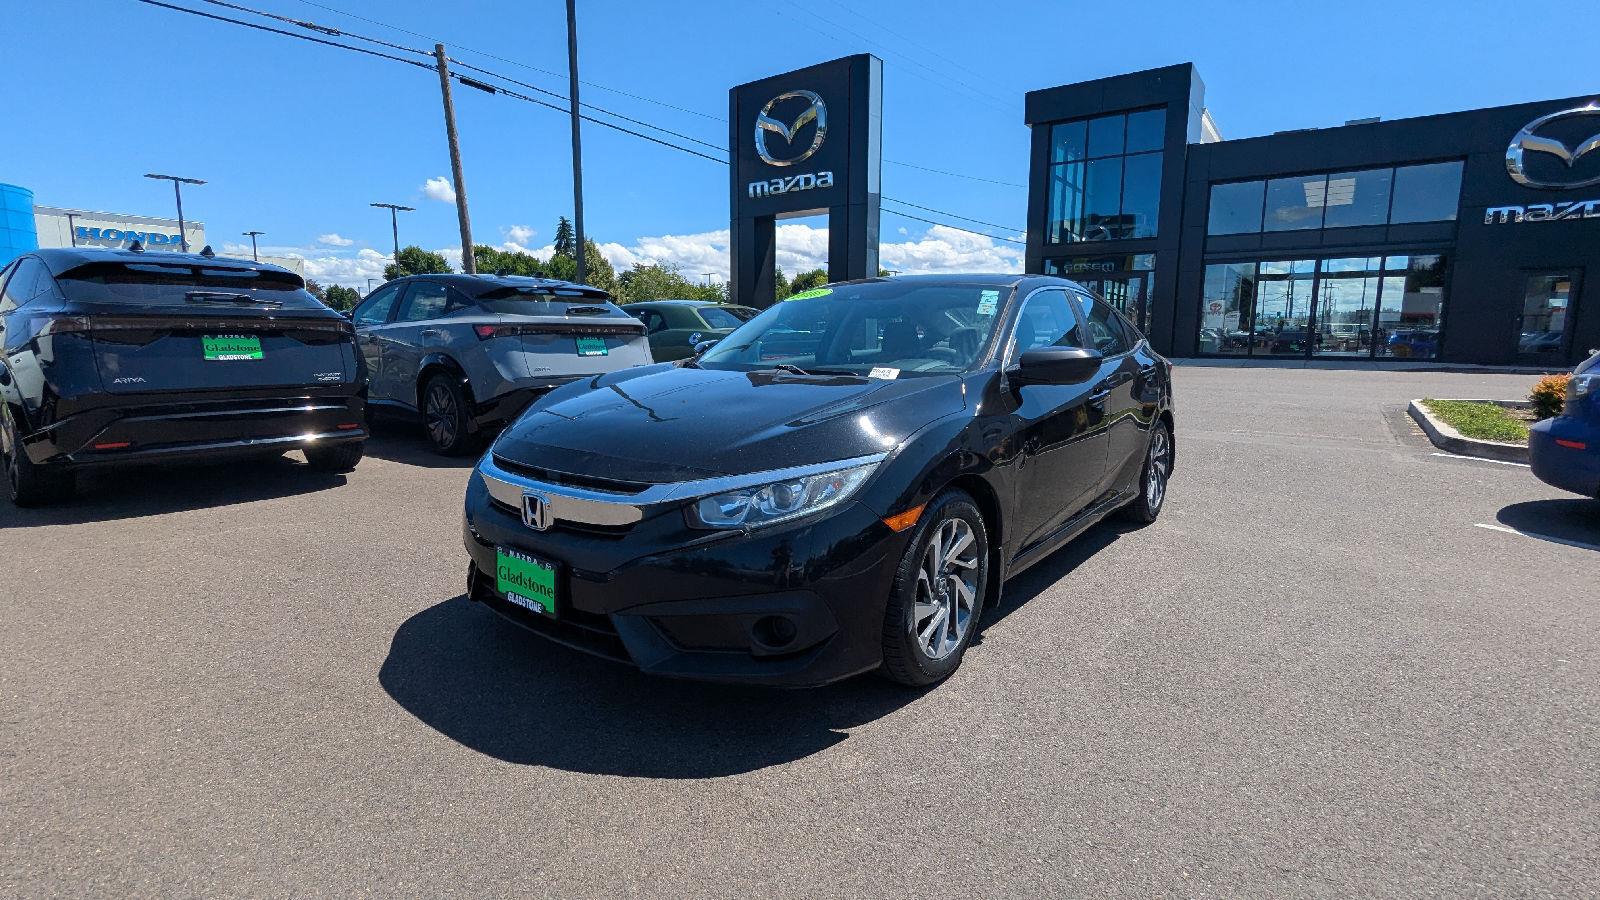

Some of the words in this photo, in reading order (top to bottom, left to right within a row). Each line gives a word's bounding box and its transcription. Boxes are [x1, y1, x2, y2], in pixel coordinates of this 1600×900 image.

[75, 225, 187, 246] HONDA
[498, 565, 554, 599] Gladstone
[507, 591, 542, 614] GLADSTONE
